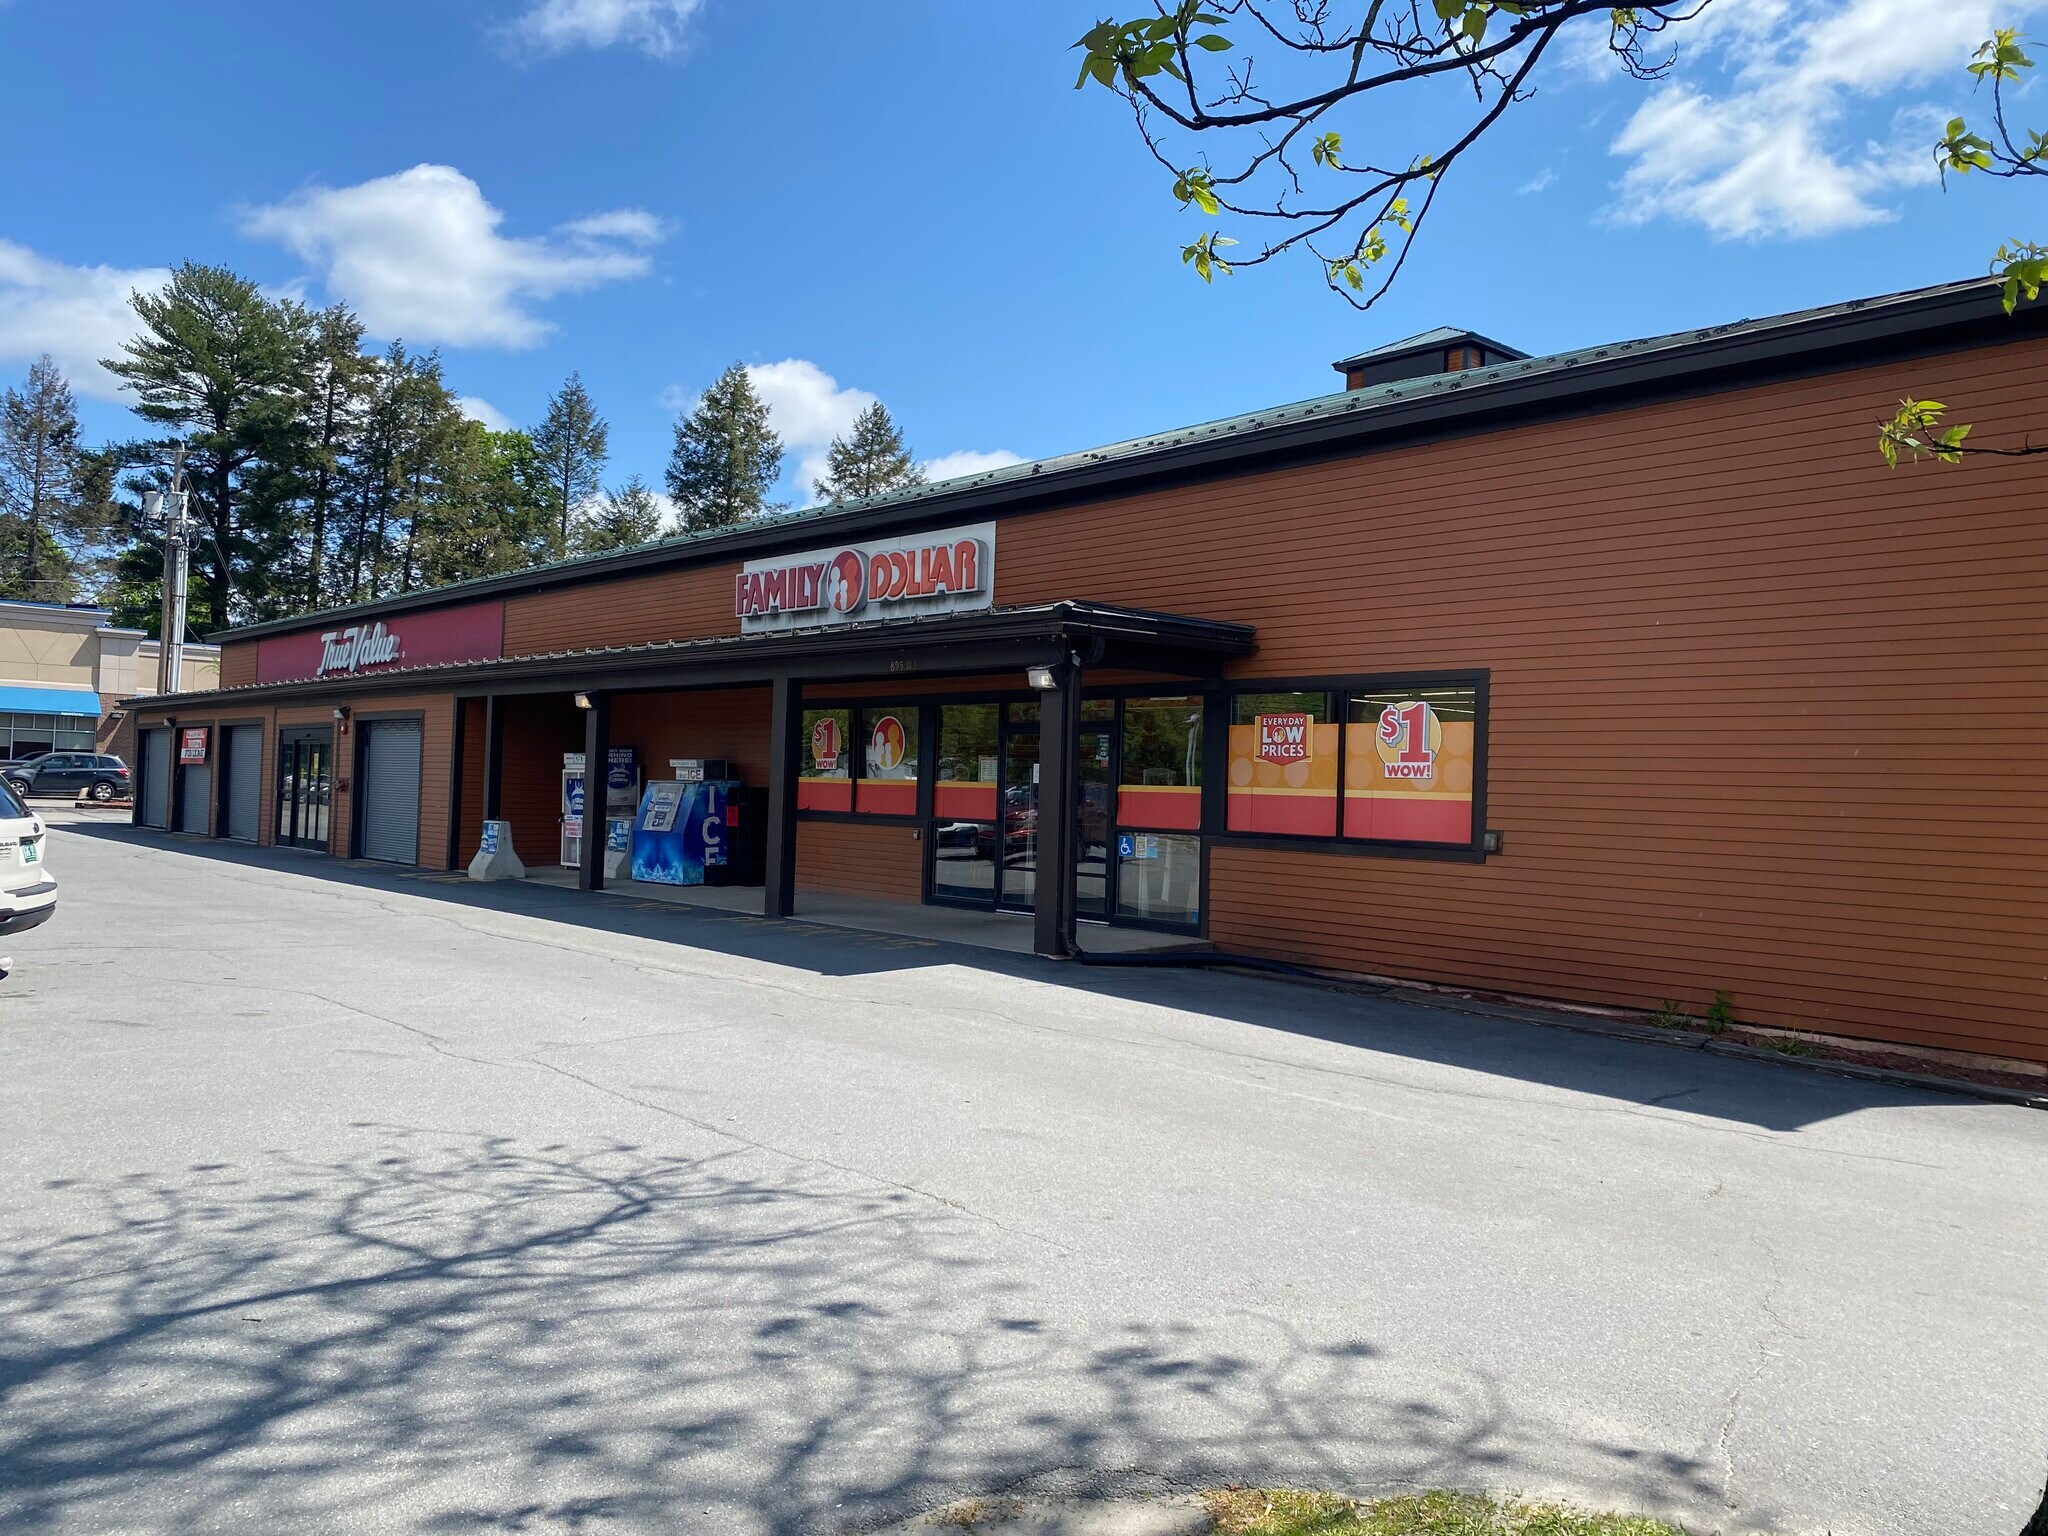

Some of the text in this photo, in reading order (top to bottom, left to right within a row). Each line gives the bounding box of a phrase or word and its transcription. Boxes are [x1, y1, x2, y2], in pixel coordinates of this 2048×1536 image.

[737, 539, 978, 615] FAMILY DOLLAR
[316, 621, 400, 676] True Value
[890, 660, 904, 672] 895
[1263, 717, 1305, 725] EVERYDAY
[813, 718, 837, 759] $1
[1262, 726, 1305, 744] LOW
[1380, 702, 1433, 763] $1
[1262, 744, 1304, 757] PRICES
[816, 760, 836, 769] WOW!
[1386, 764, 1431, 778] WOW!
[687, 769, 702, 780] ICE
